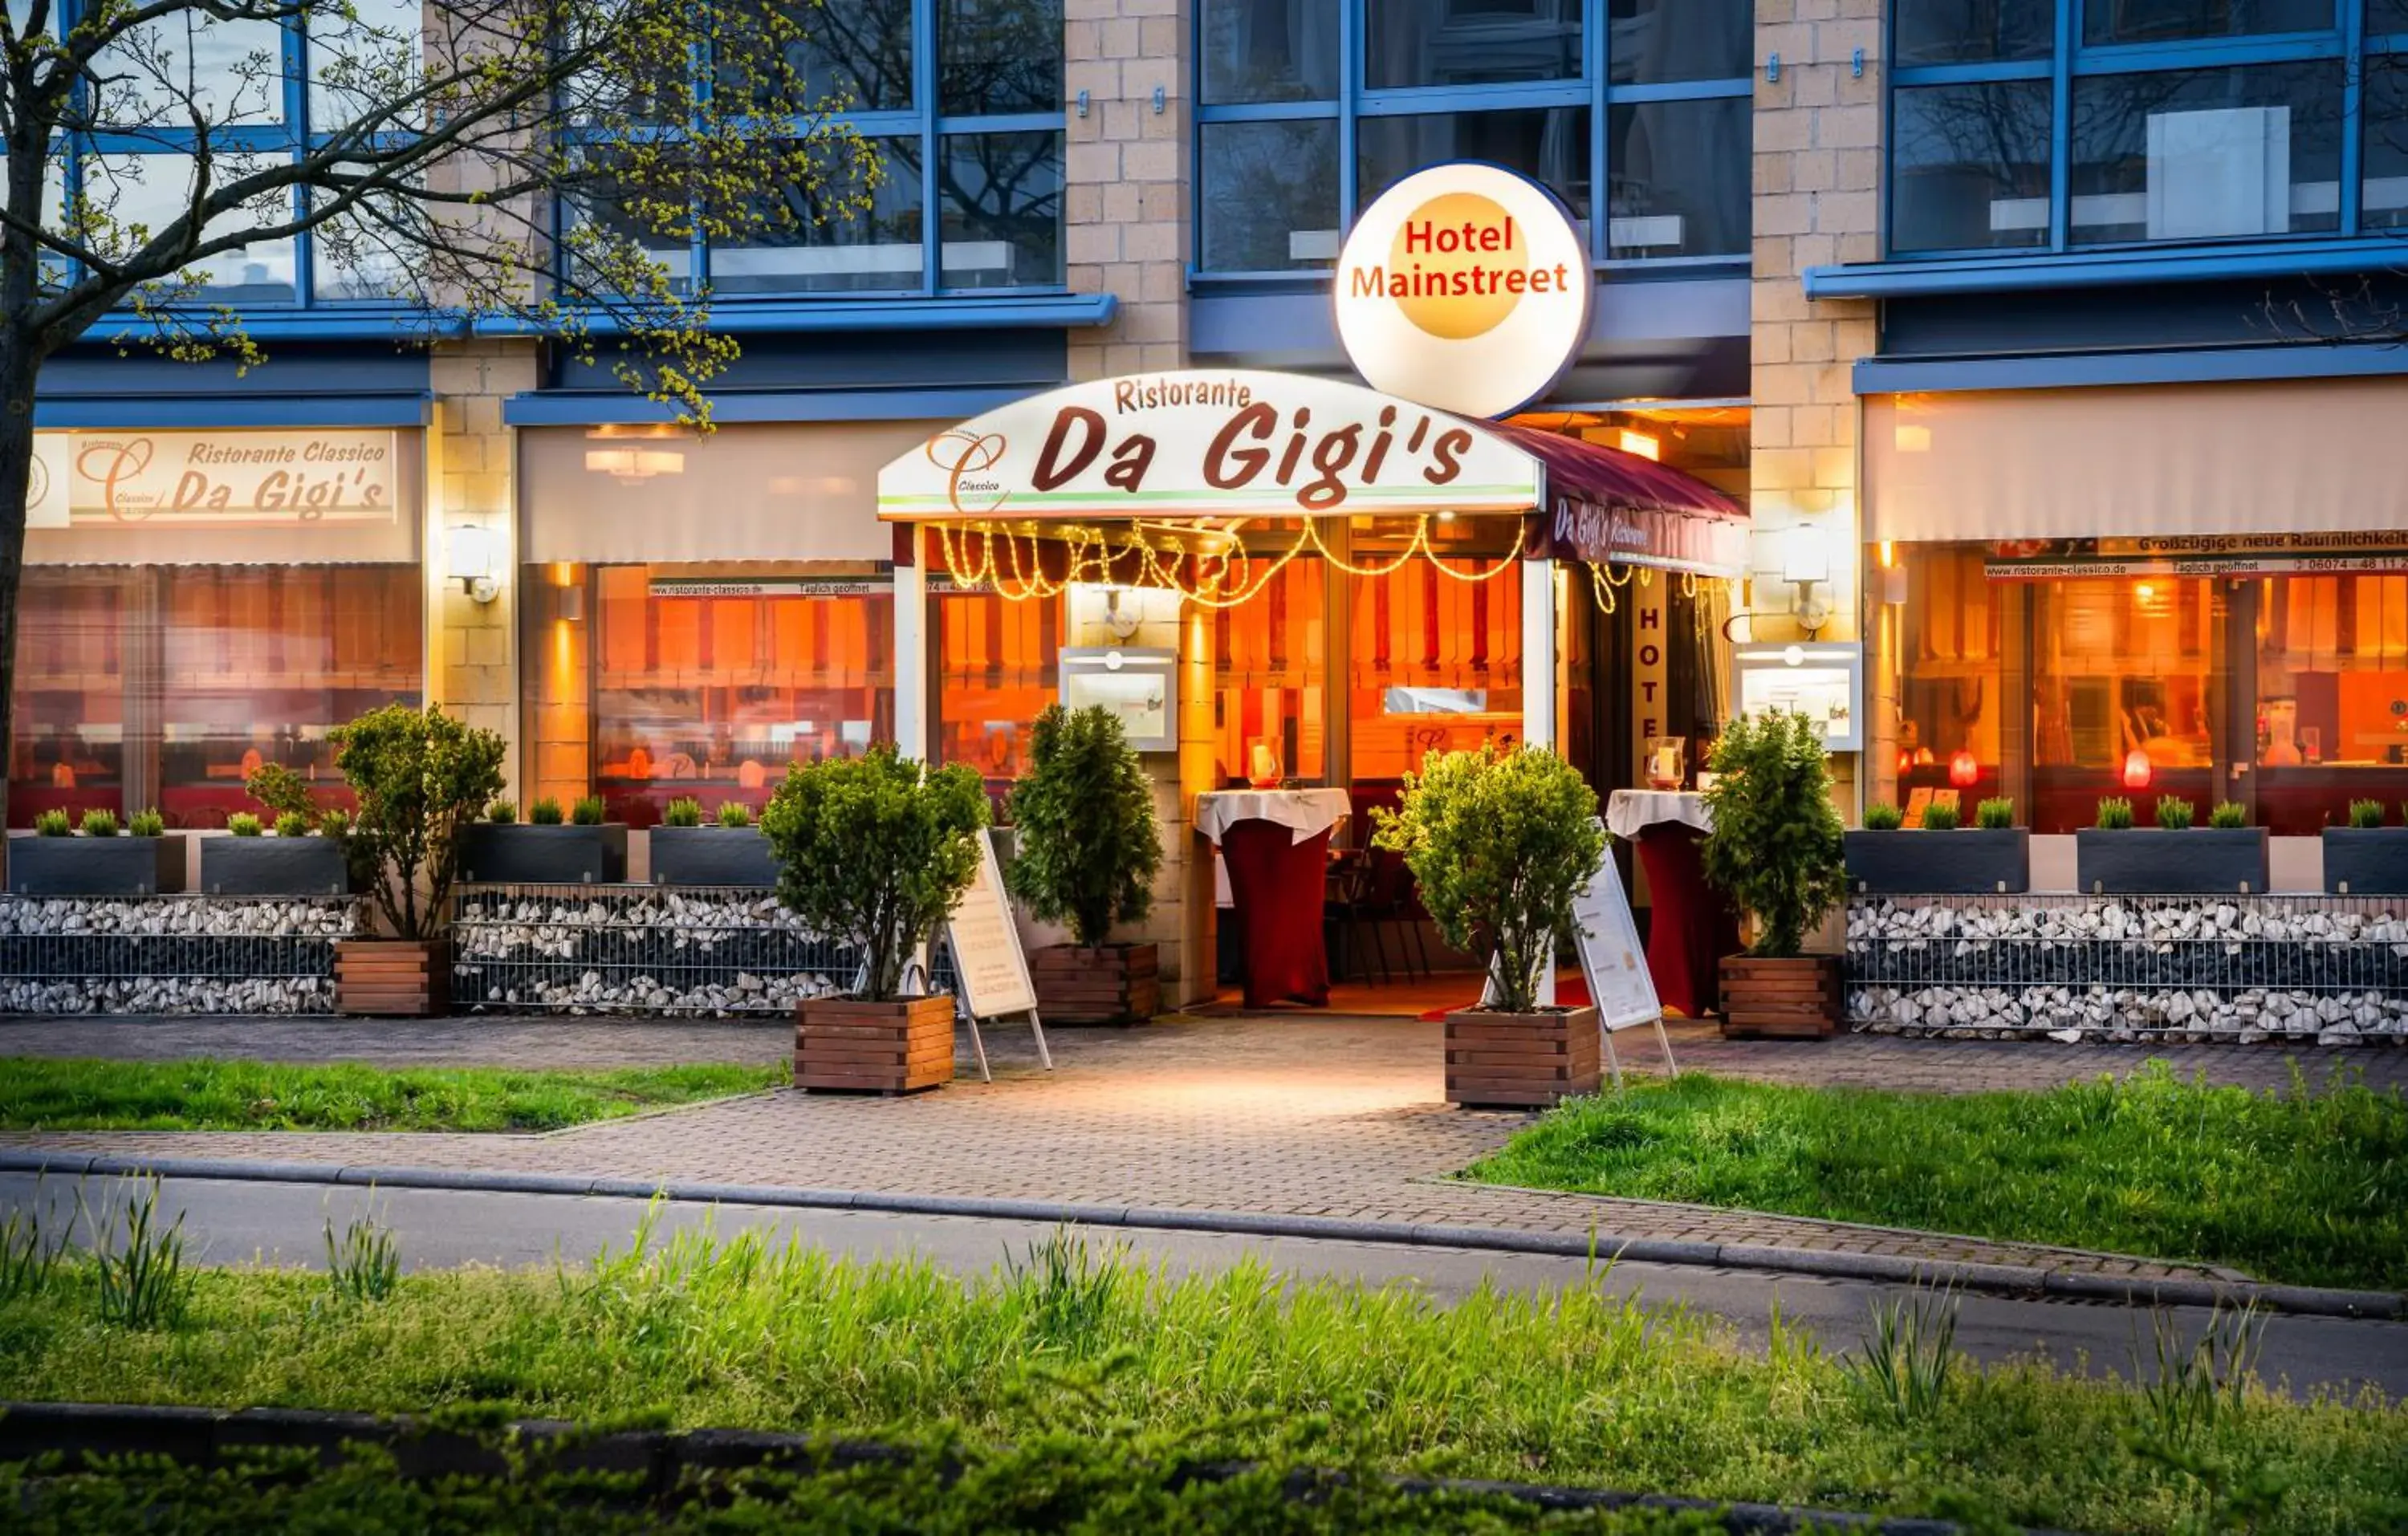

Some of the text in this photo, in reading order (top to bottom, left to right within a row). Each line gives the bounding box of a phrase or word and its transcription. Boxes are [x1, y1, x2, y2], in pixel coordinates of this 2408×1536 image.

[1405, 216, 1513, 254] Hotel
[1351, 263, 1568, 298] Mainstreet
[1113, 380, 1252, 415] Ristorante
[188, 441, 385, 465] Ristorante Classico
[1031, 401, 1473, 510] Da Gigi's
[171, 466, 383, 522] Da Gigi's
[958, 480, 1000, 491] Classico
[1554, 498, 1574, 543] Da
[2139, 535, 2237, 552] Großzügige
[2243, 534, 2285, 548] neue
[1639, 607, 1659, 776] HOTE
